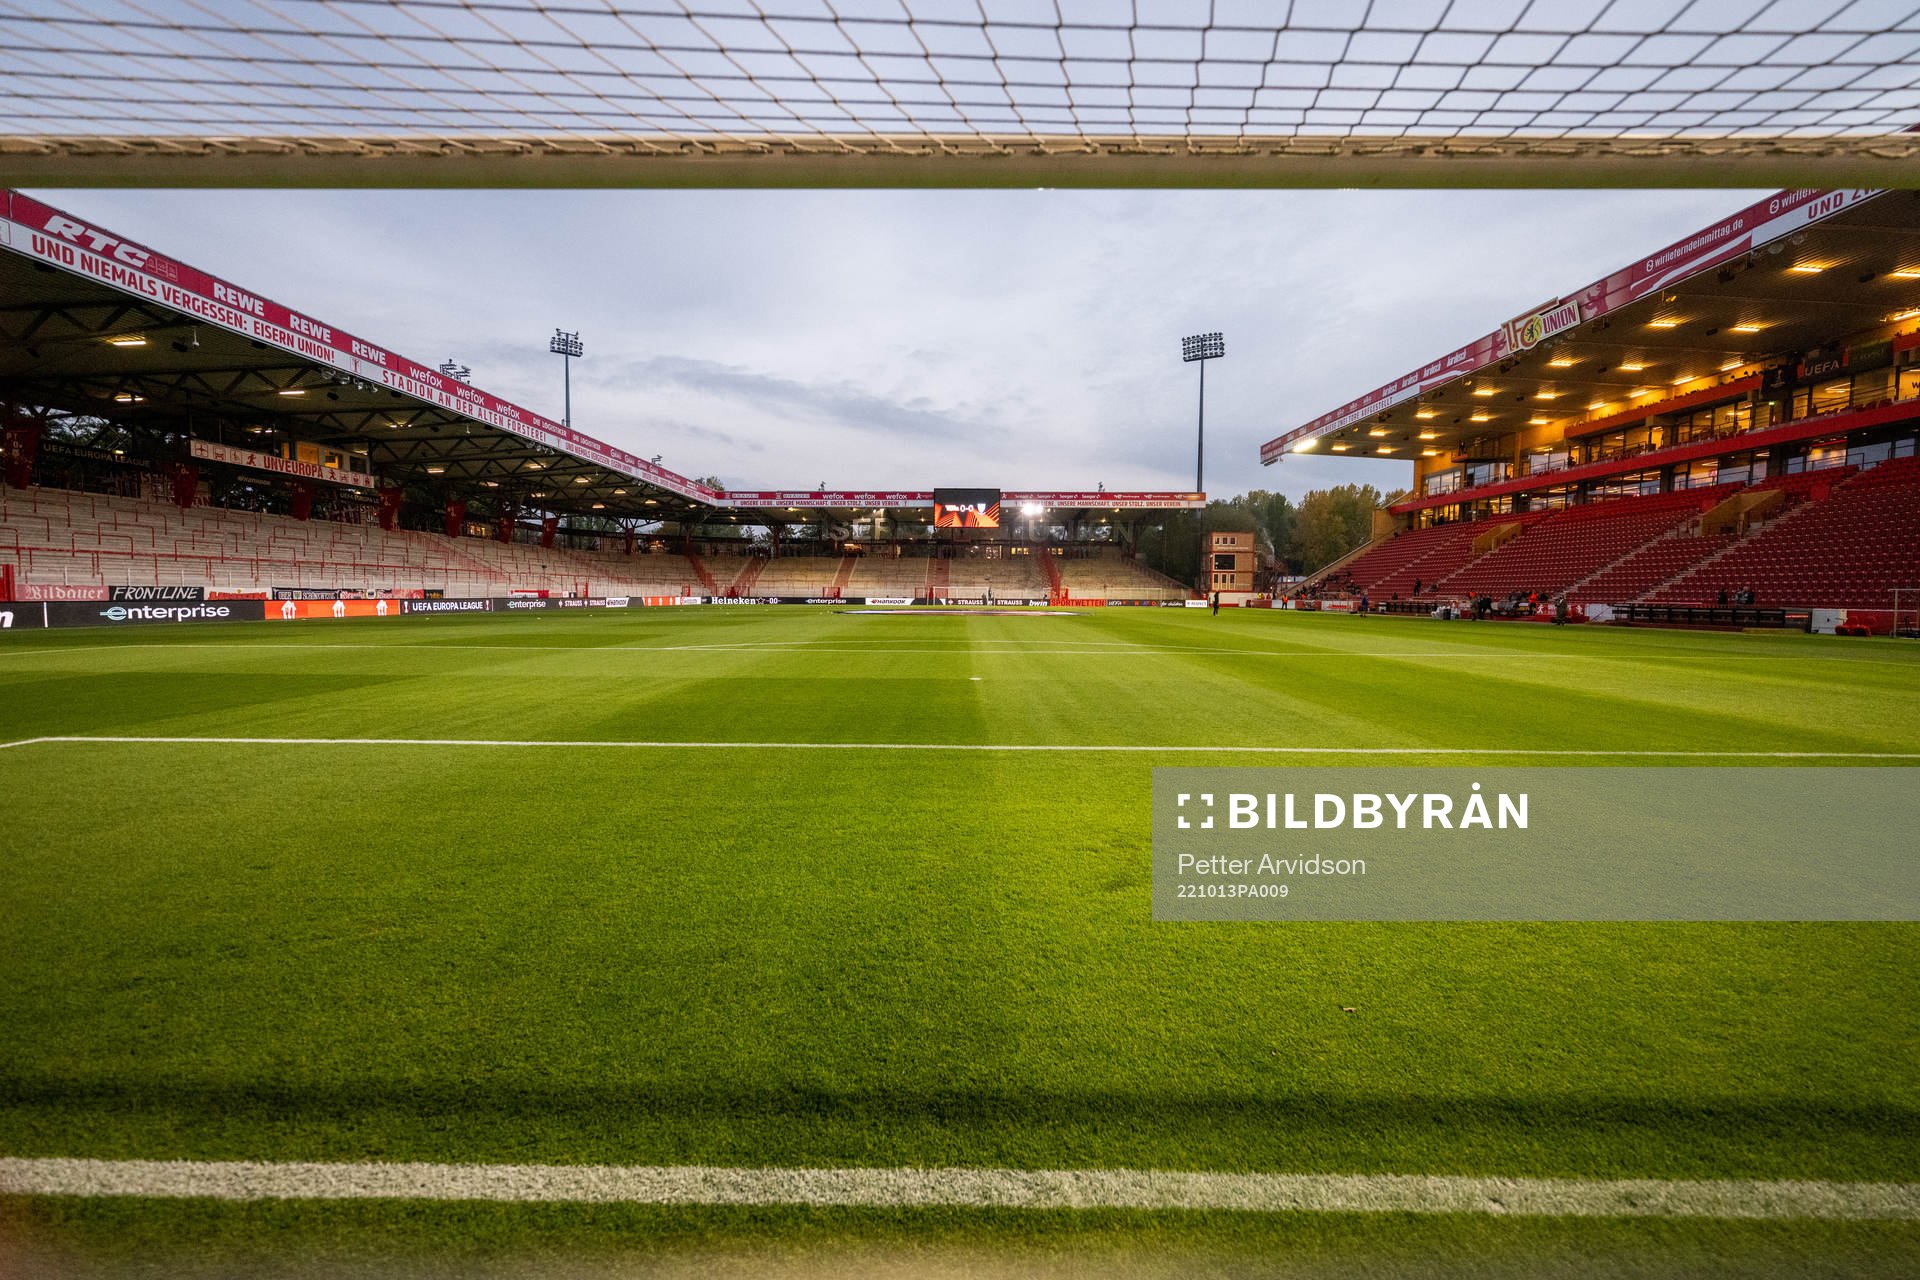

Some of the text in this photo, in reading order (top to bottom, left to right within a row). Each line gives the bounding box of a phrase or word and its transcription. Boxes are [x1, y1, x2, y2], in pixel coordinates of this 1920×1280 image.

[1808, 192, 1844, 219] UND
[43, 215, 151, 268] RTC
[1655, 218, 1743, 267] wirlieferndeinmittag.de
[32, 234, 335, 364] UND NIEMALS VERGESSEN: EISERN UNION!
[214, 282, 264, 317] REWE
[290, 314, 331, 344] REWE
[1543, 305, 1577, 334] UNION
[352, 340, 387, 365] REWE
[410, 366, 443, 389] wefox
[1804, 360, 1841, 377] UEFA
[383, 370, 433, 400] STADION
[438, 394, 451, 407] AN
[456, 400, 473, 414] DER
[478, 408, 504, 428] ALTEN
[457, 387, 485, 406] wefox
[496, 402, 521, 419] wefox
[42, 442, 72, 456] UEFA
[263, 456, 324, 478] UNVEUROPA
[113, 586, 199, 600] FRONTLINE
[565, 599, 583, 607] STRAUSS
[711, 597, 756, 605] Heineken
[1050, 599, 1106, 607] SPORTWETTEN
[99, 603, 230, 622] enterprise
[412, 600, 483, 611] UEFA EUROPA LEAGUE
[507, 599, 546, 609] enterprise
